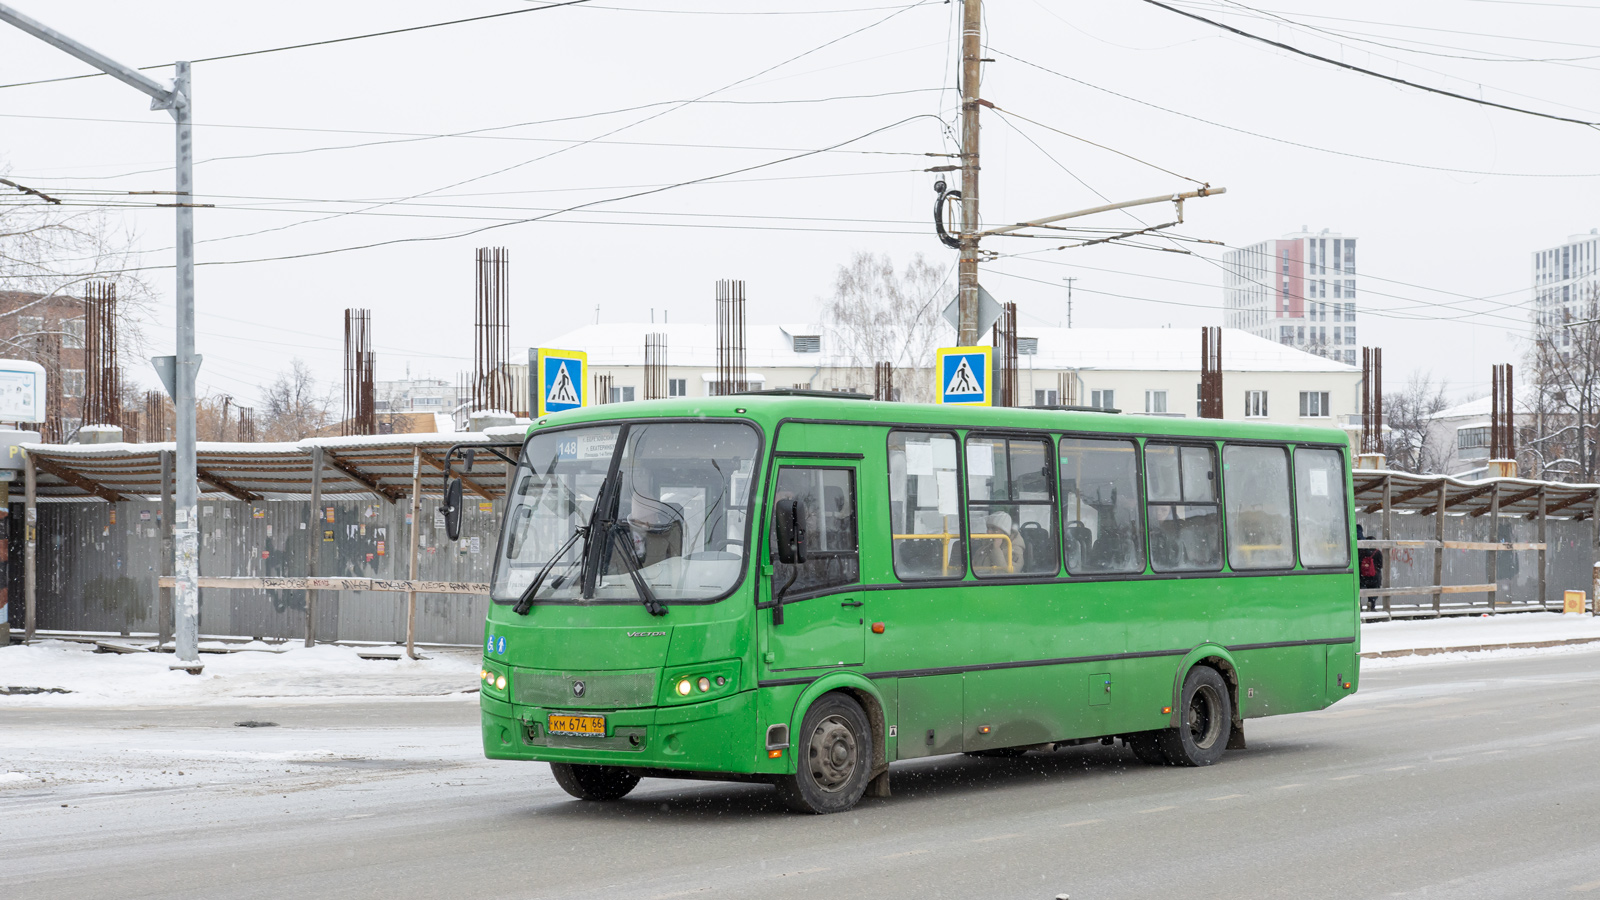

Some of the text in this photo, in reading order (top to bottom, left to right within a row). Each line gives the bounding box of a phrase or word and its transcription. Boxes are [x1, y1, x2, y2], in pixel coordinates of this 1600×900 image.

[559, 441, 577, 455] 148
[590, 443, 616, 452] ЕКАТЕРИНБУ
[569, 718, 587, 731] 674
[592, 718, 602, 728] 66
